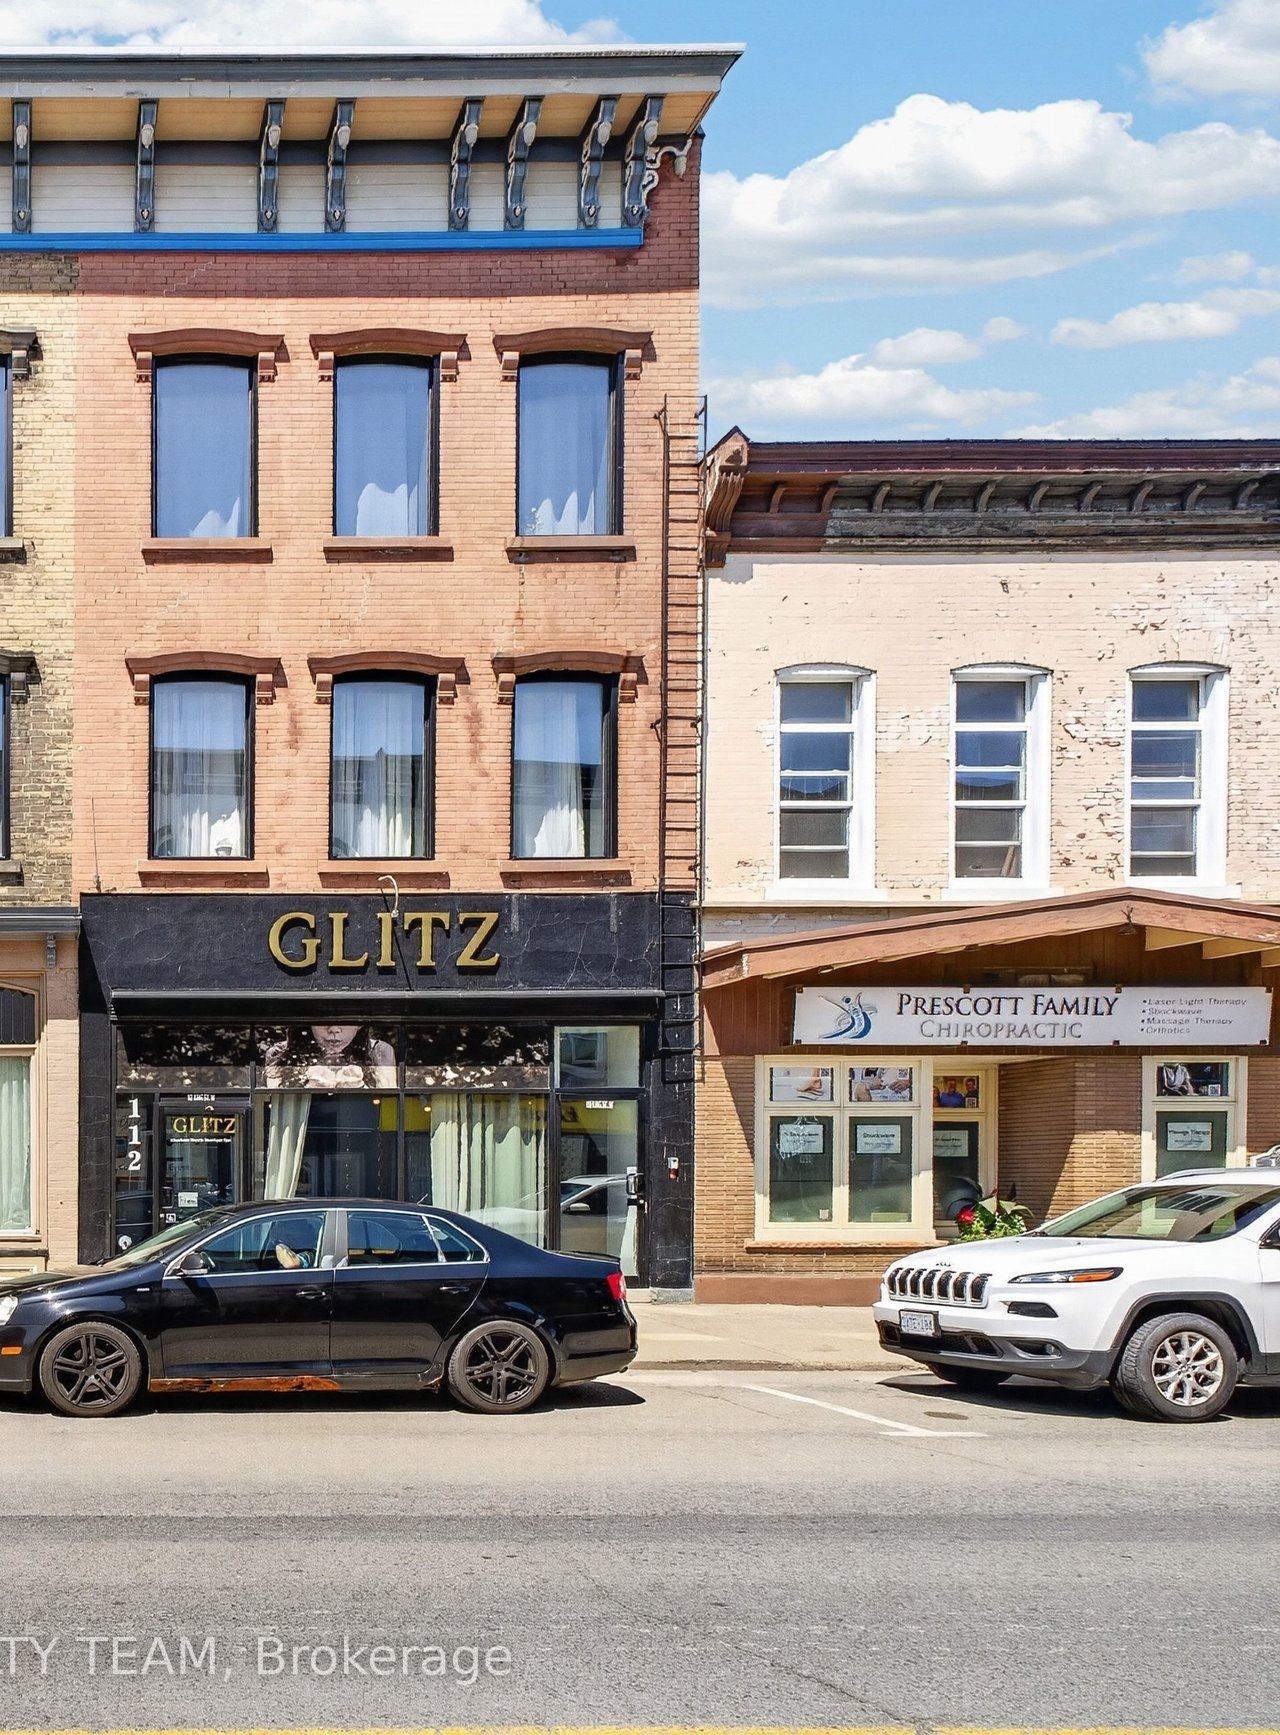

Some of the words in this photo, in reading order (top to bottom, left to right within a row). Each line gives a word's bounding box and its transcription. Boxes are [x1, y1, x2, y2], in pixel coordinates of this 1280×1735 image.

[269, 912, 500, 968] GLITZ
[896, 993, 1023, 1016] PRESCOTT
[1031, 994, 1119, 1016] FAMILY
[1180, 998, 1203, 1006] Light
[920, 1019, 1083, 1039] CHIROPRACTIC
[1146, 1026, 1191, 1034] Orthotics
[173, 1116, 236, 1133] GLITZ
